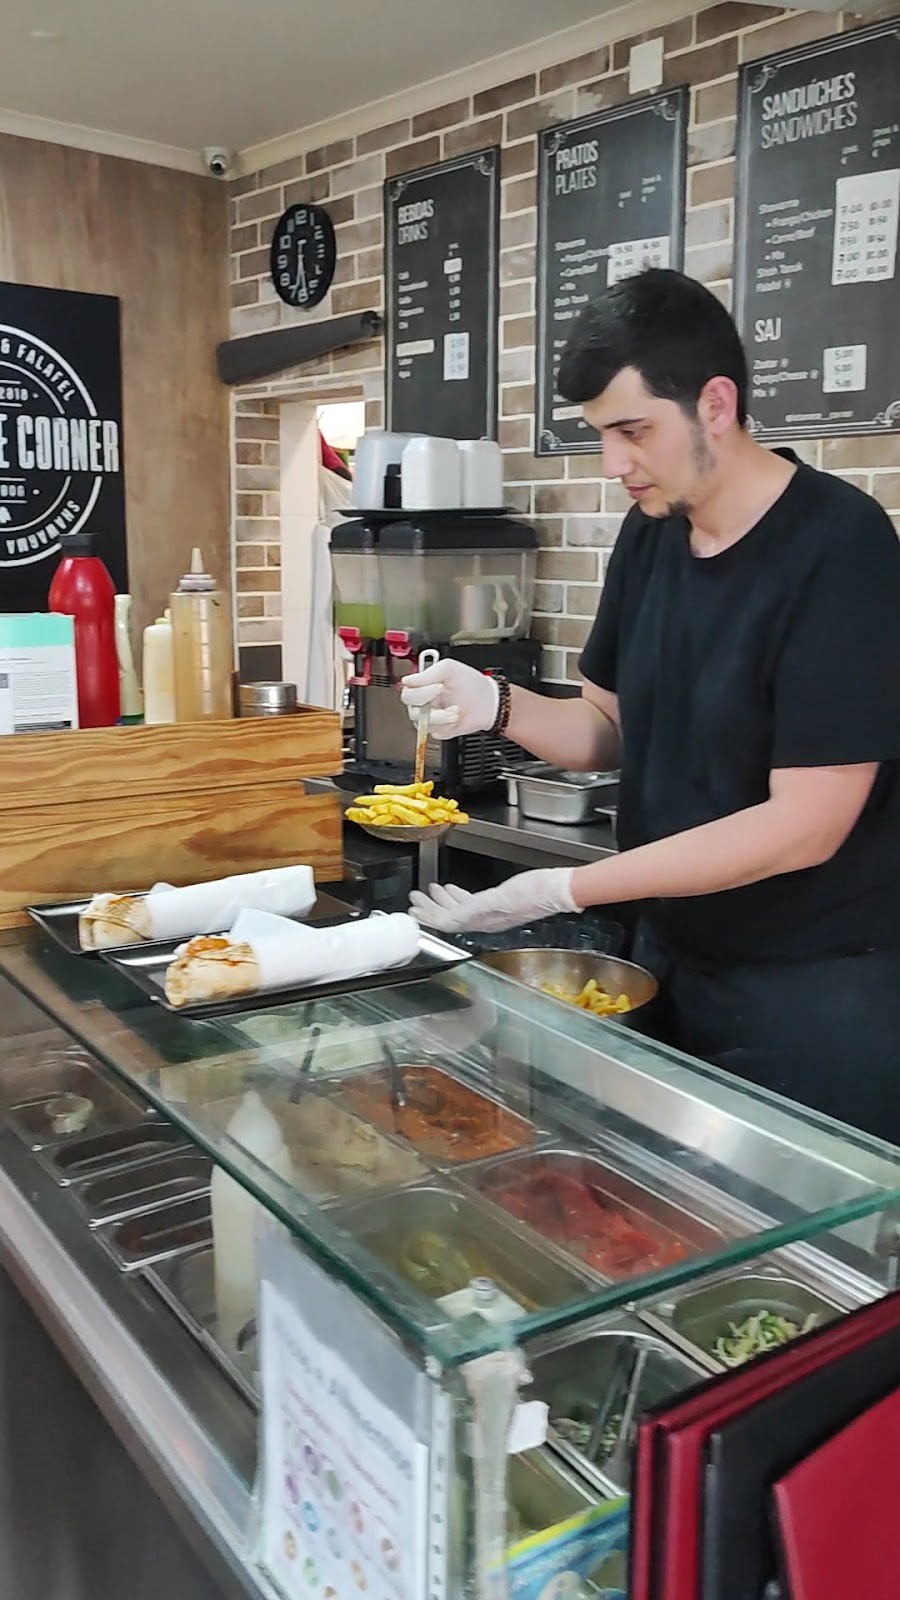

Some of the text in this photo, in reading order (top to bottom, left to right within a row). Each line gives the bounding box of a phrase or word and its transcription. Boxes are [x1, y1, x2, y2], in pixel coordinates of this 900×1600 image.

[762, 72, 856, 120] SANDUÍCHES
[761, 101, 858, 149] SANDWICHES
[556, 140, 599, 171] PRATOS
[556, 166, 597, 195] PLATES
[754, 317, 782, 343] SAJ
[16, 343, 76, 402] FALAFEL
[16, 414, 120, 473] CORNER
